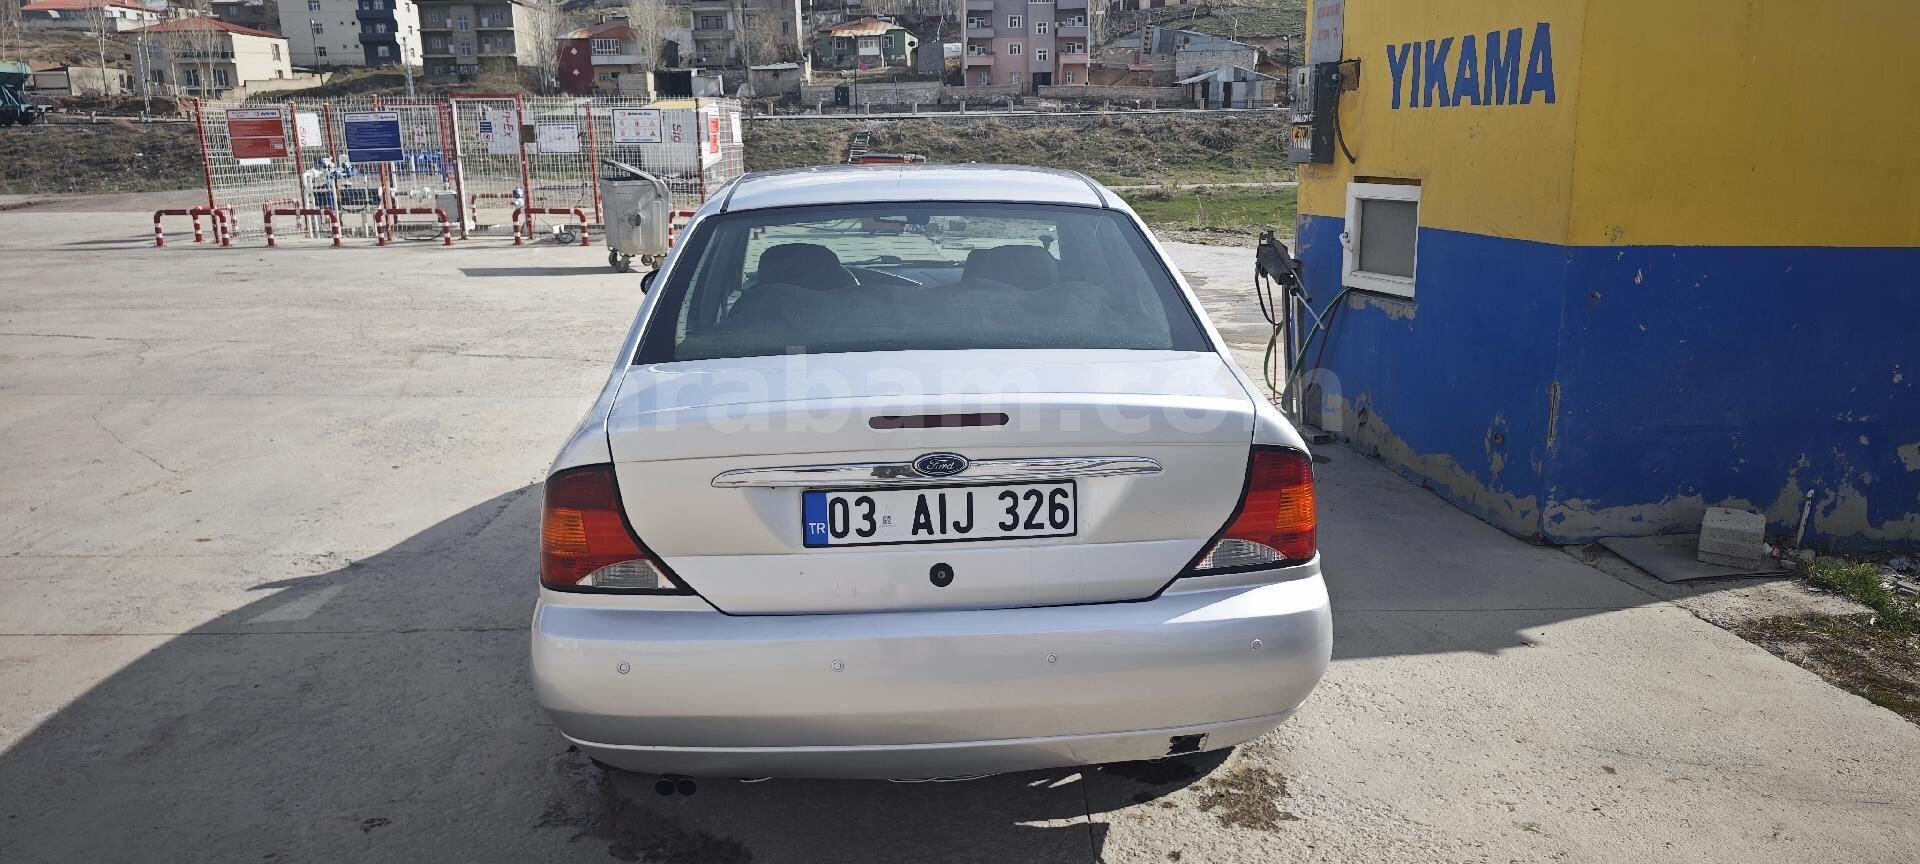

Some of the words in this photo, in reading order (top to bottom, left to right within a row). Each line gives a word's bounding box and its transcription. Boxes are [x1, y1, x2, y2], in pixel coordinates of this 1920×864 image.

[1386, 22, 1556, 110] YIKAMA
[926, 459, 955, 470] Ford
[808, 522, 826, 535] TR
[829, 496, 877, 539] 03
[911, 491, 974, 536] AIJ
[998, 487, 1070, 532] 326
